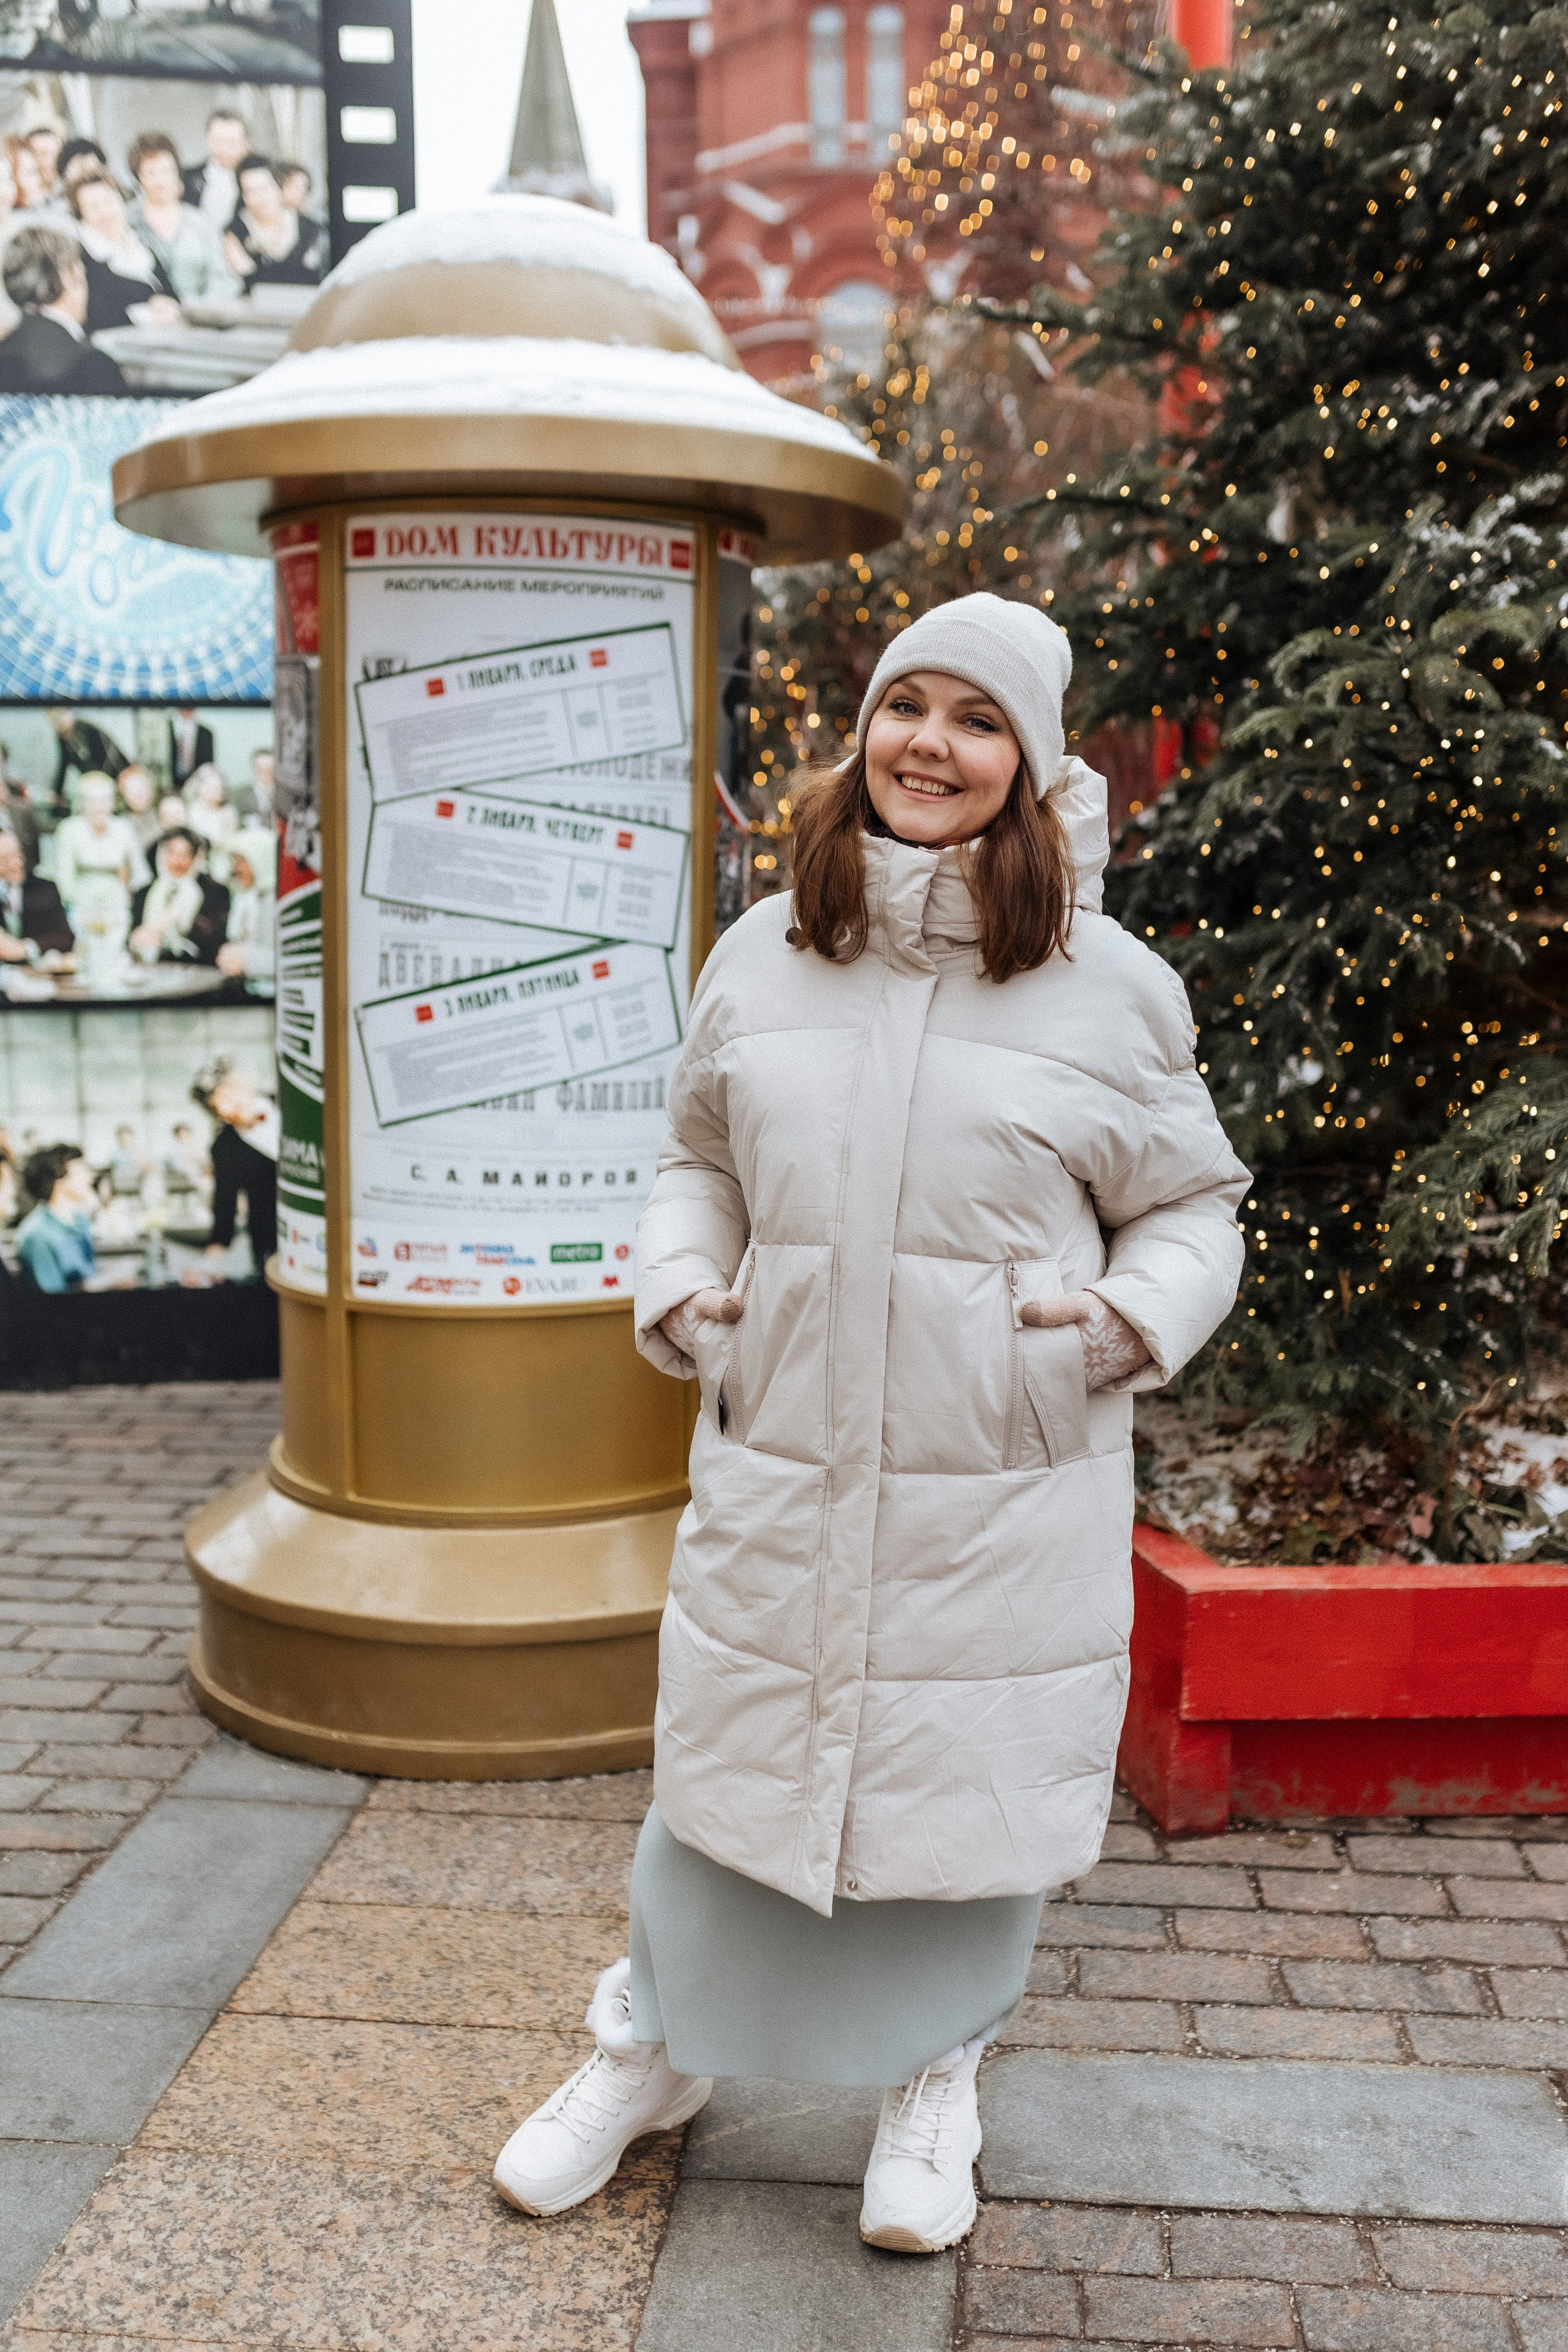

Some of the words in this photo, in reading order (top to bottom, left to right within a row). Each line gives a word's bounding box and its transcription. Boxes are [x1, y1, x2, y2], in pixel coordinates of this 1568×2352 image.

[383, 526, 459, 558] ДОМ
[473, 525, 663, 567] КУЛЬТУРЫ
[384, 578, 515, 592] РАСПИСАНИЕ
[521, 579, 665, 600] МЕРОПРИЯТИЙ
